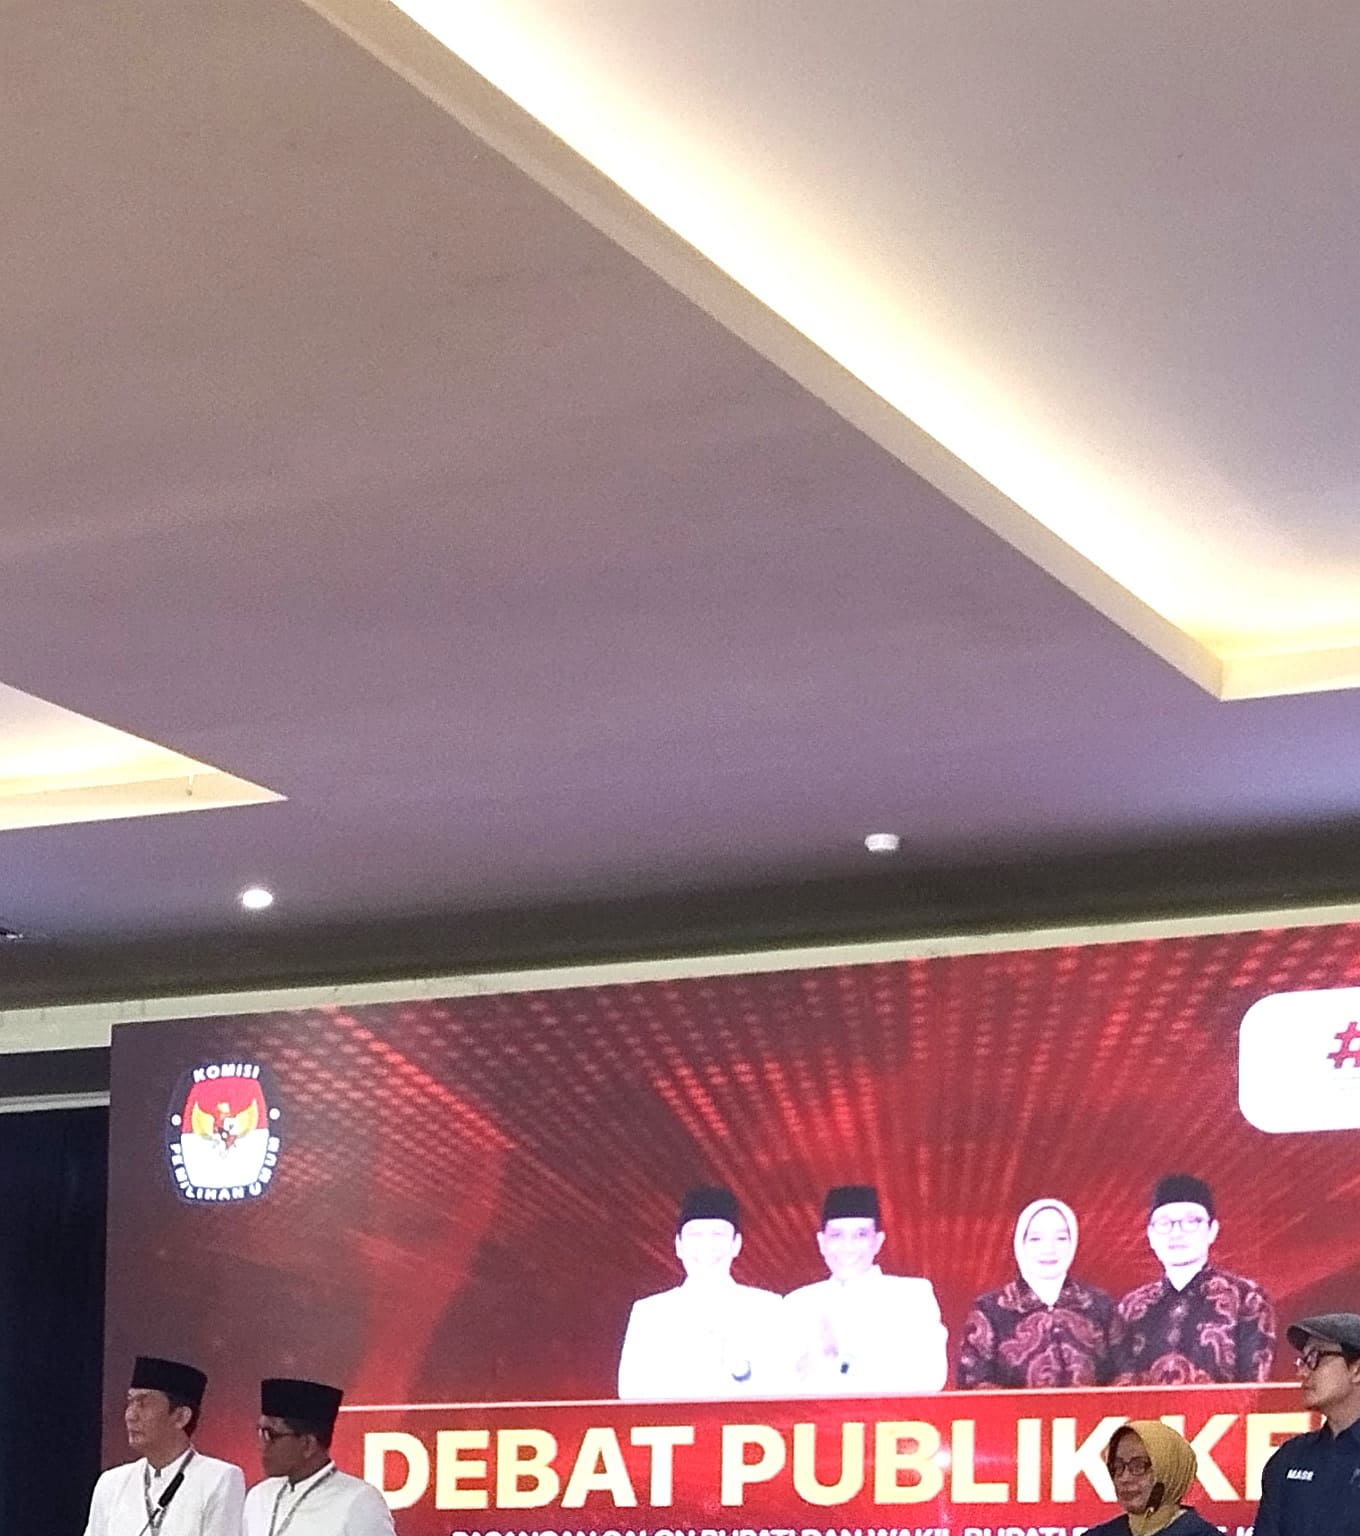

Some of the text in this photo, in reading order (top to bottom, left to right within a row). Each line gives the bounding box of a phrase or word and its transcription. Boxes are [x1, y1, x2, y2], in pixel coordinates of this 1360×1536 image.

[192, 1063, 260, 1083] KOMISI
[362, 1424, 696, 1511] DEBAT
[720, 1414, 1129, 1508] PUBLIK
